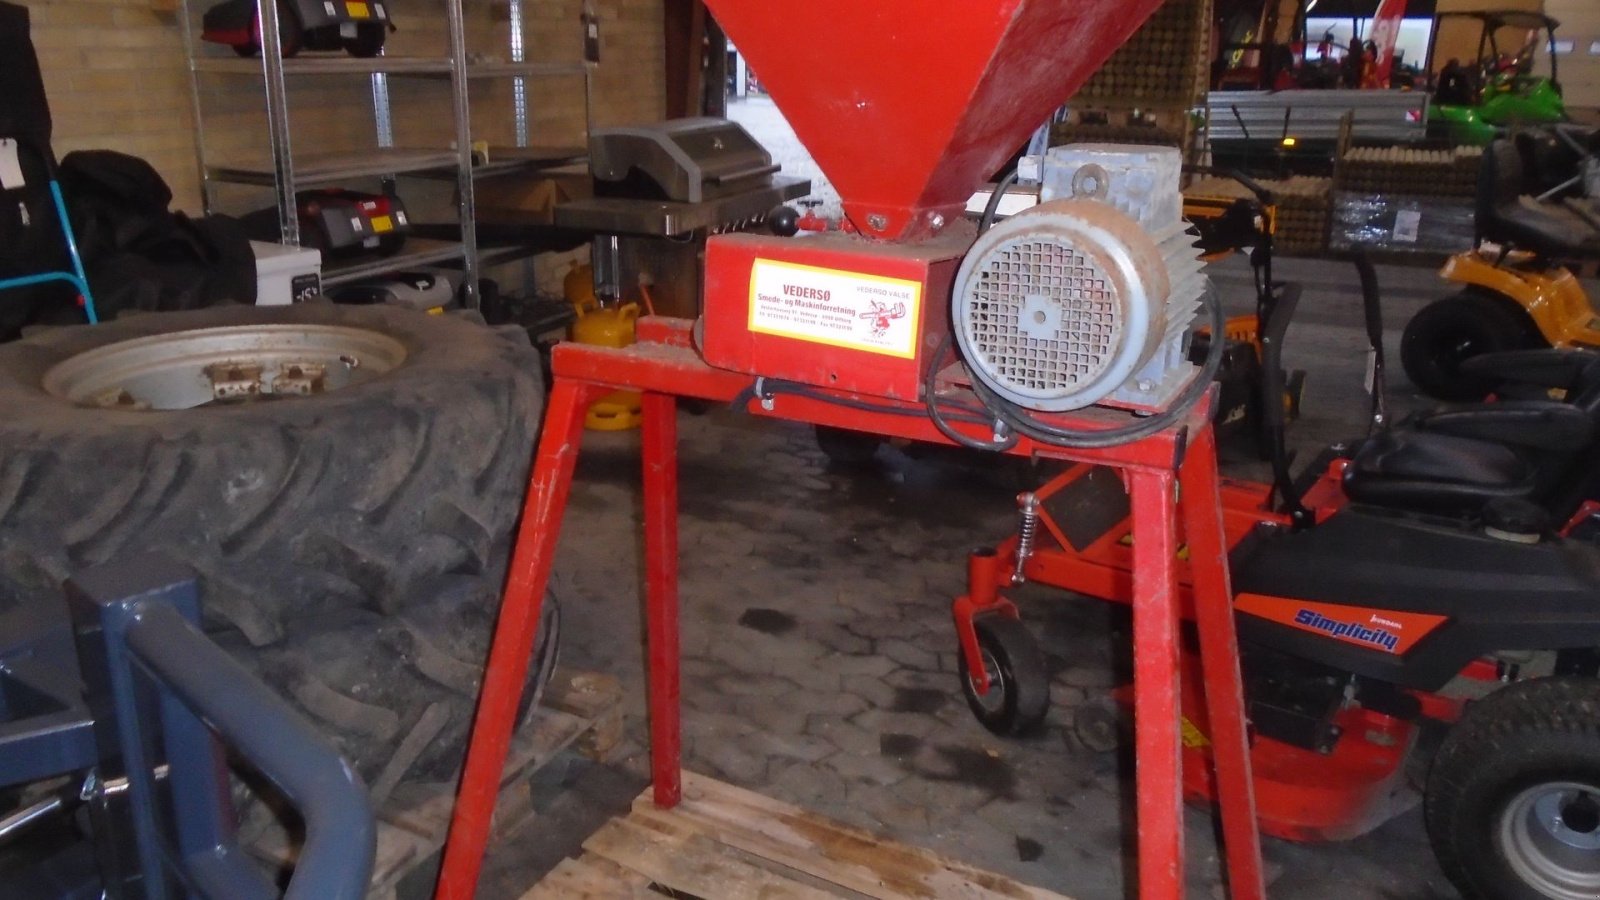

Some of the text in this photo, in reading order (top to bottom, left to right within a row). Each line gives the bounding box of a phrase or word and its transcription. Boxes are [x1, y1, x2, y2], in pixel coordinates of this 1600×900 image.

[758, 293, 784, 304] Smede-
[784, 299, 794, 308] og
[794, 299, 856, 317] Maskinforretning
[783, 284, 831, 302] VEDERSØ
[1294, 608, 1400, 654] Simplicity
